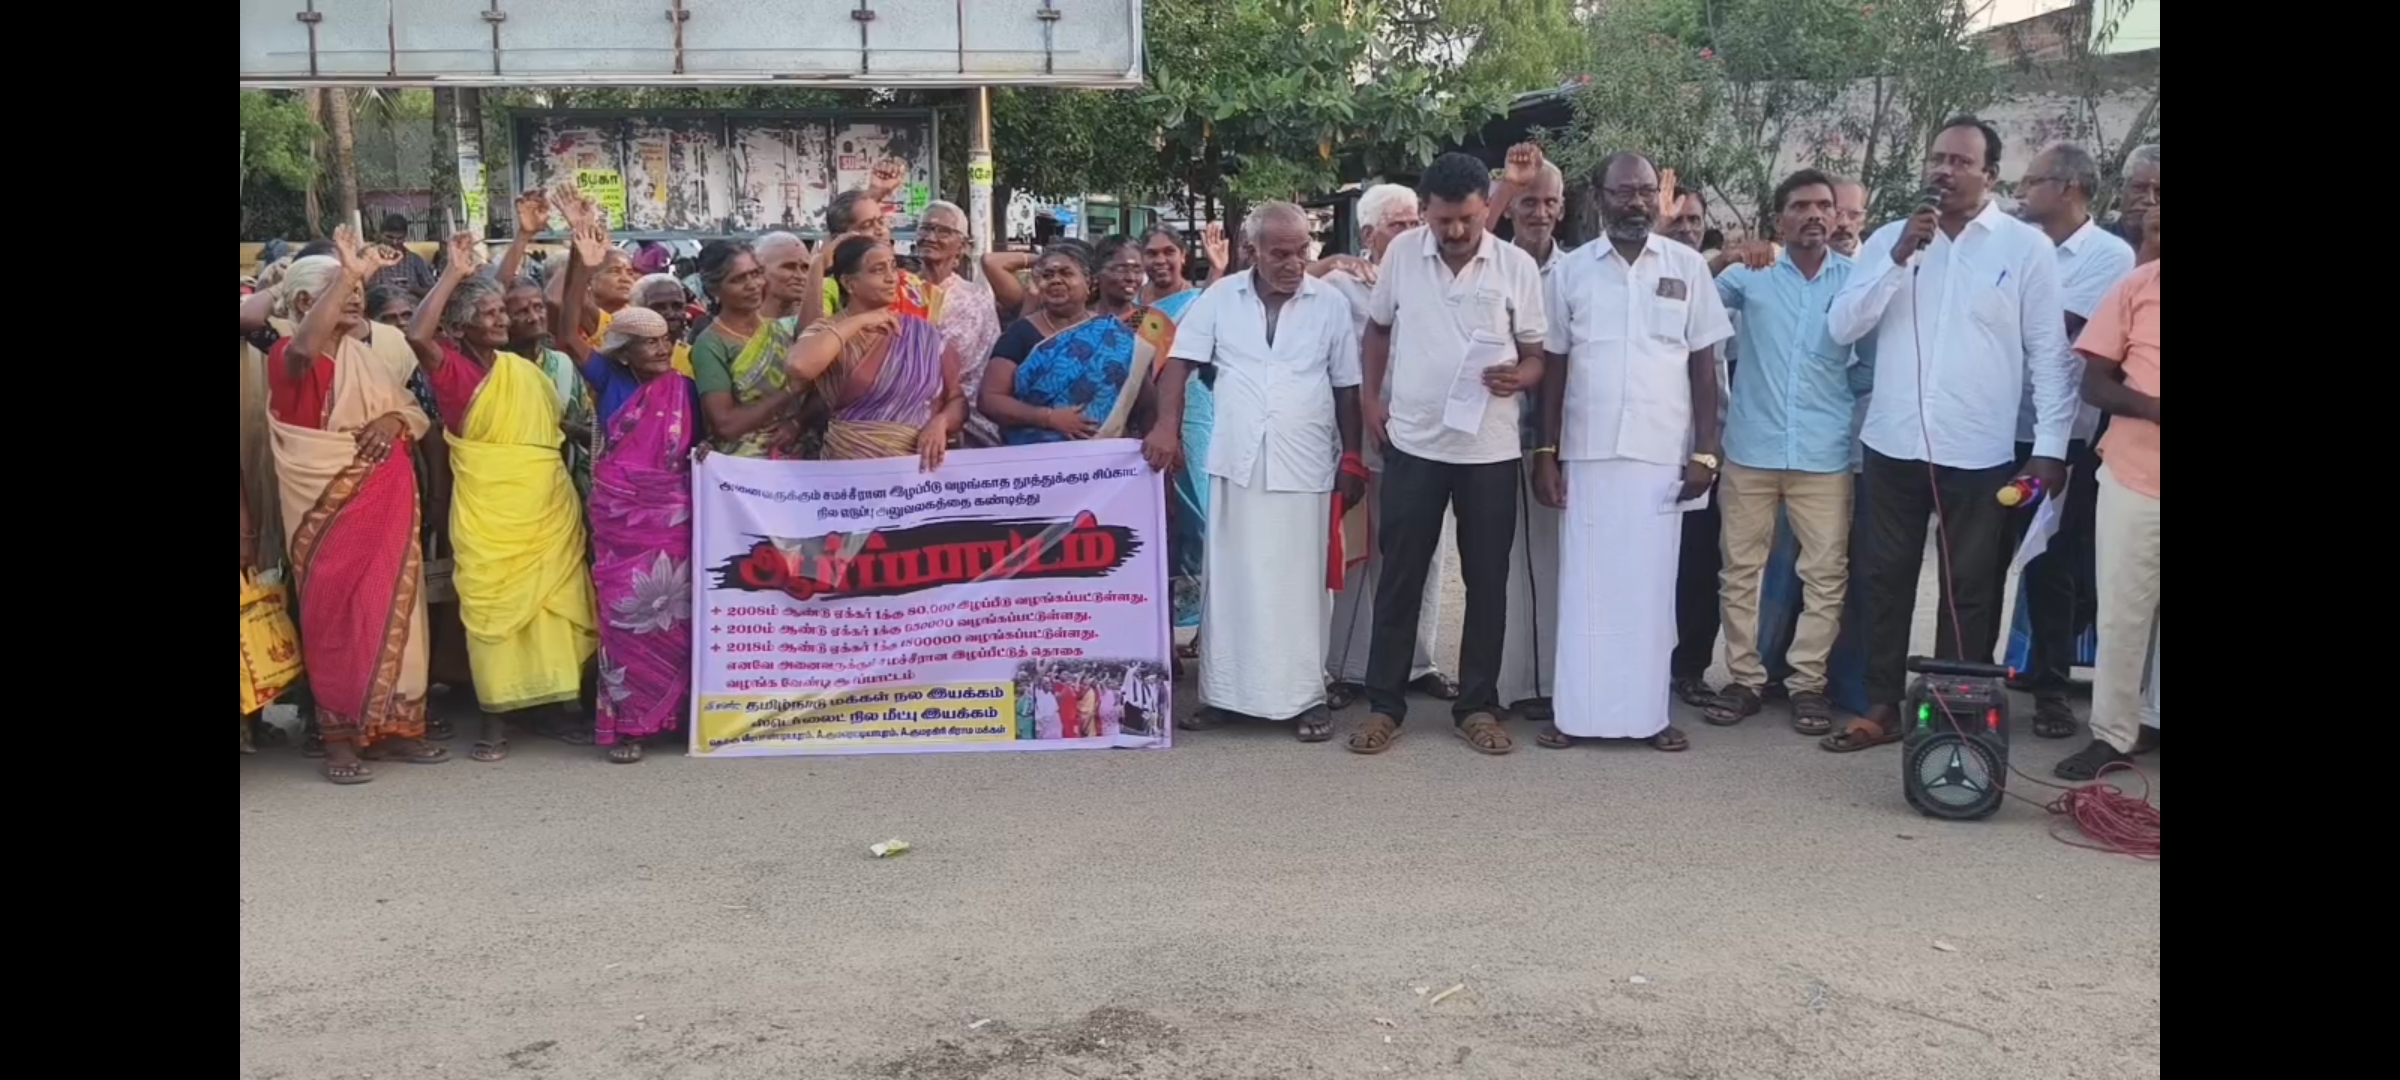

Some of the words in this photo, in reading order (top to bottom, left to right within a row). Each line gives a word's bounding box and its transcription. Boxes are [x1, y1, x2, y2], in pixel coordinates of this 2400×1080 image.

[823, 486, 887, 502] சமச்சீரான
[889, 479, 942, 500] இழப்பீடு
[945, 475, 1010, 494] வழங்காத
[1013, 470, 1090, 490] தூத்துக்குடி
[1092, 467, 1138, 481] சிப்காட்
[817, 506, 839, 521] நில
[841, 504, 874, 520] எடுப்பு
[876, 494, 972, 520] அலுவலகத்தை
[974, 491, 1041, 508] கண்டித்து
[739, 509, 1118, 600] ஆர்ப்பாட்டம்
[727, 604, 779, 618] 2008ம்
[782, 606, 831, 619] ஆண்டு
[834, 606, 872, 620] ஏக்கர்
[876, 607, 904, 621] 1க்கு
[956, 595, 1012, 613] இழப்பீடு
[1015, 590, 1148, 607] வழங்கப்பட்டுள்ளது.
[727, 621, 775, 634] 2010ம்
[779, 622, 828, 637] ஆண்டு
[831, 624, 868, 637] ஏக்கர்
[873, 623, 902, 637] 1க்கு
[957, 609, 1092, 629] வழங்கப்பட்டுள்ளது.
[727, 639, 775, 653] 2018ம்
[779, 640, 828, 655] ஆண்டு
[830, 641, 869, 655] ஏக்கர்
[965, 628, 1099, 644] வழங்கப்பட்டுள்ளது.
[726, 659, 774, 671] எனவே
[952, 645, 1029, 662] இழப்பீட்டுத்
[1031, 646, 1084, 659] தொகை
[726, 675, 778, 690] வழங்க
[781, 674, 832, 689] வேண்டி
[746, 698, 827, 714] தமிழ்நாடு
[831, 691, 889, 706] மக்கள்
[894, 690, 923, 702] நல
[926, 686, 1004, 700] இயக்கம்
[850, 710, 879, 724] நில
[921, 705, 998, 720] இயக்கம்
